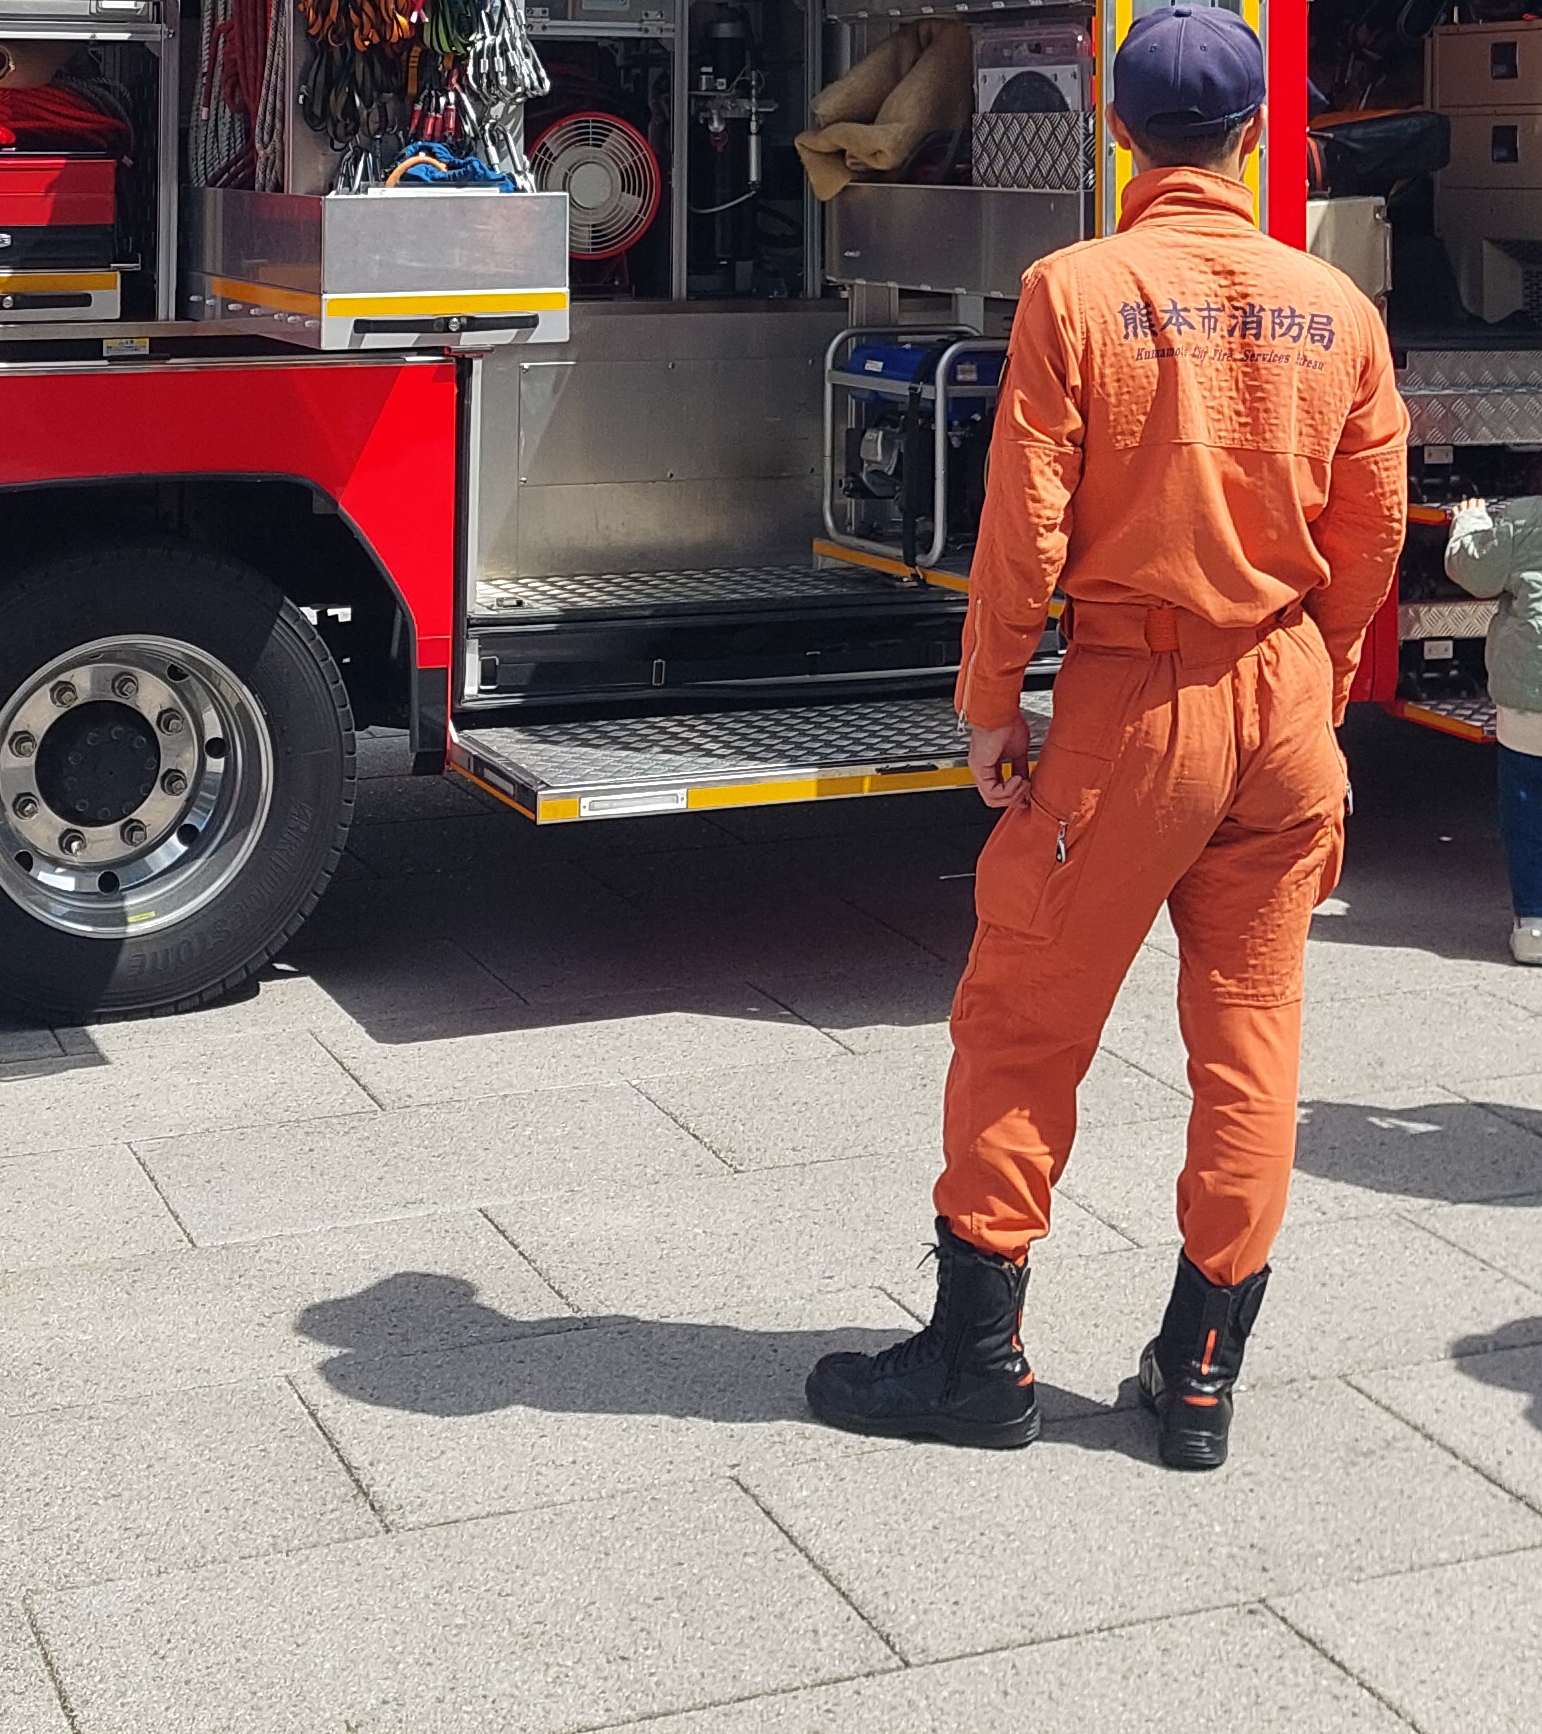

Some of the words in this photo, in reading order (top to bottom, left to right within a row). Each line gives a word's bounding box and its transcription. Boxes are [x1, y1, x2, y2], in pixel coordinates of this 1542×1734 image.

[1116, 297, 1336, 352] 熊本市消防局
[1242, 349, 1290, 364] Services
